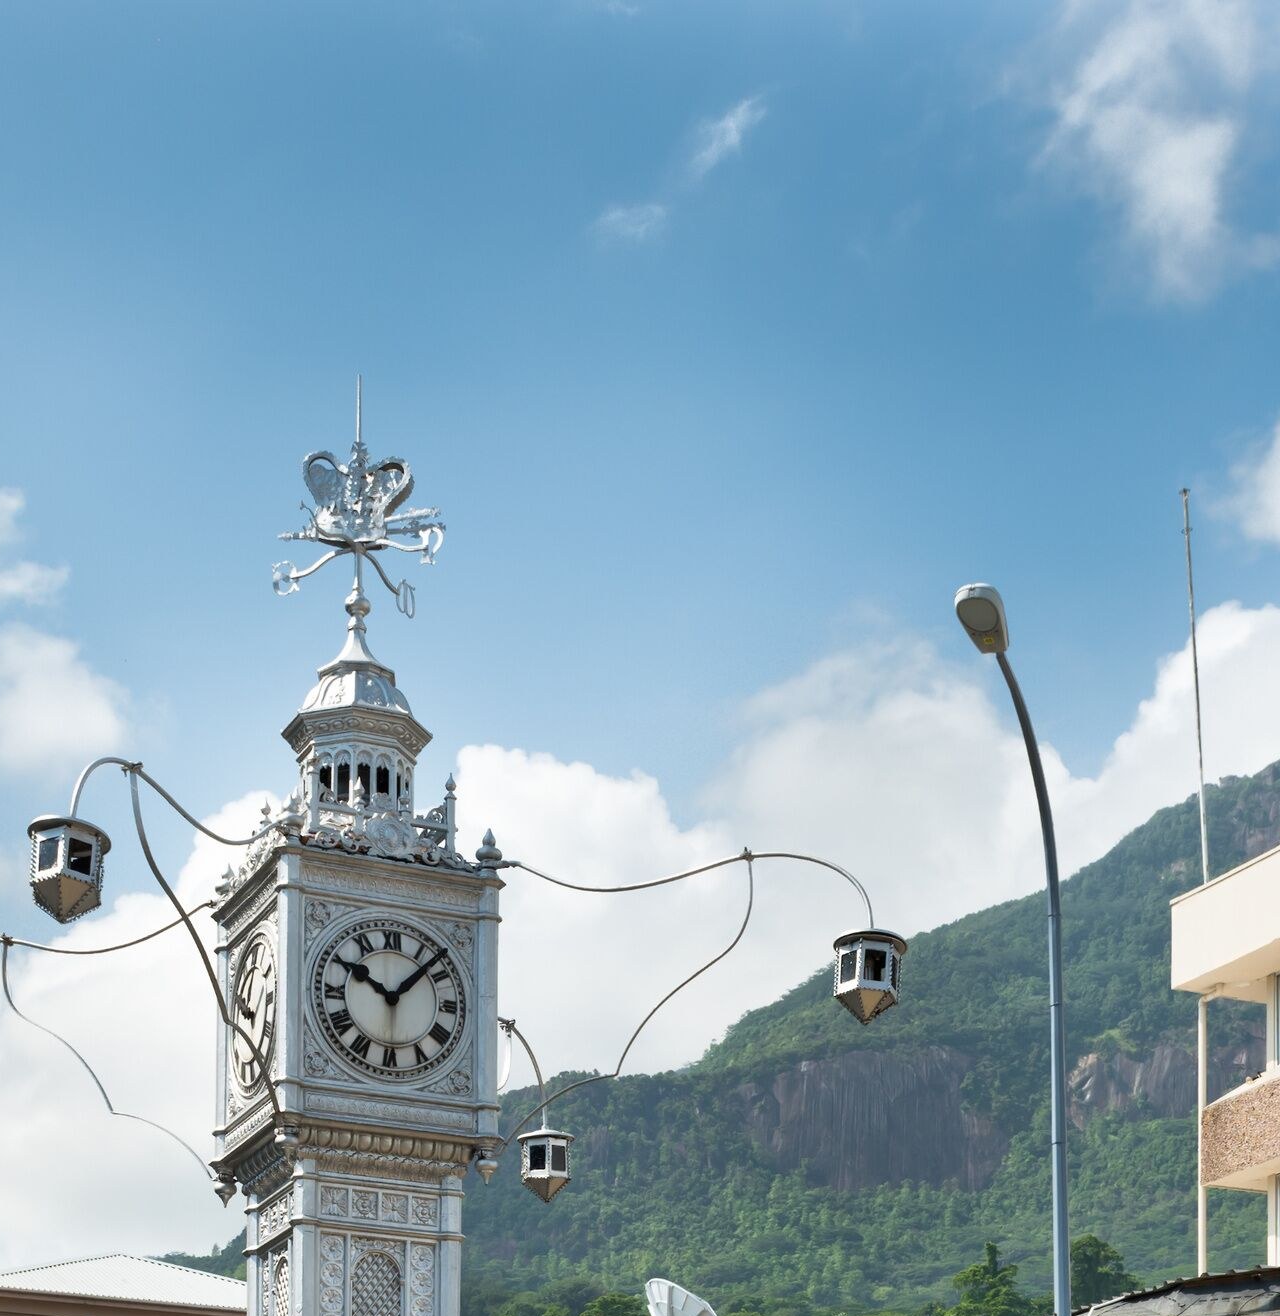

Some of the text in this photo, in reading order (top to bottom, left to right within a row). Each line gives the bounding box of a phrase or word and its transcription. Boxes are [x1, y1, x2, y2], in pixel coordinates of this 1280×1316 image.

[352, 933, 374, 957] XI
[383, 931, 401, 951] XII
[431, 969, 450, 983] II
[325, 982, 346, 1000] IX
[439, 999, 457, 1014] III
[349, 1034, 371, 1060] VII
[383, 1047, 398, 1067] VI
[414, 1043, 428, 1064] V
